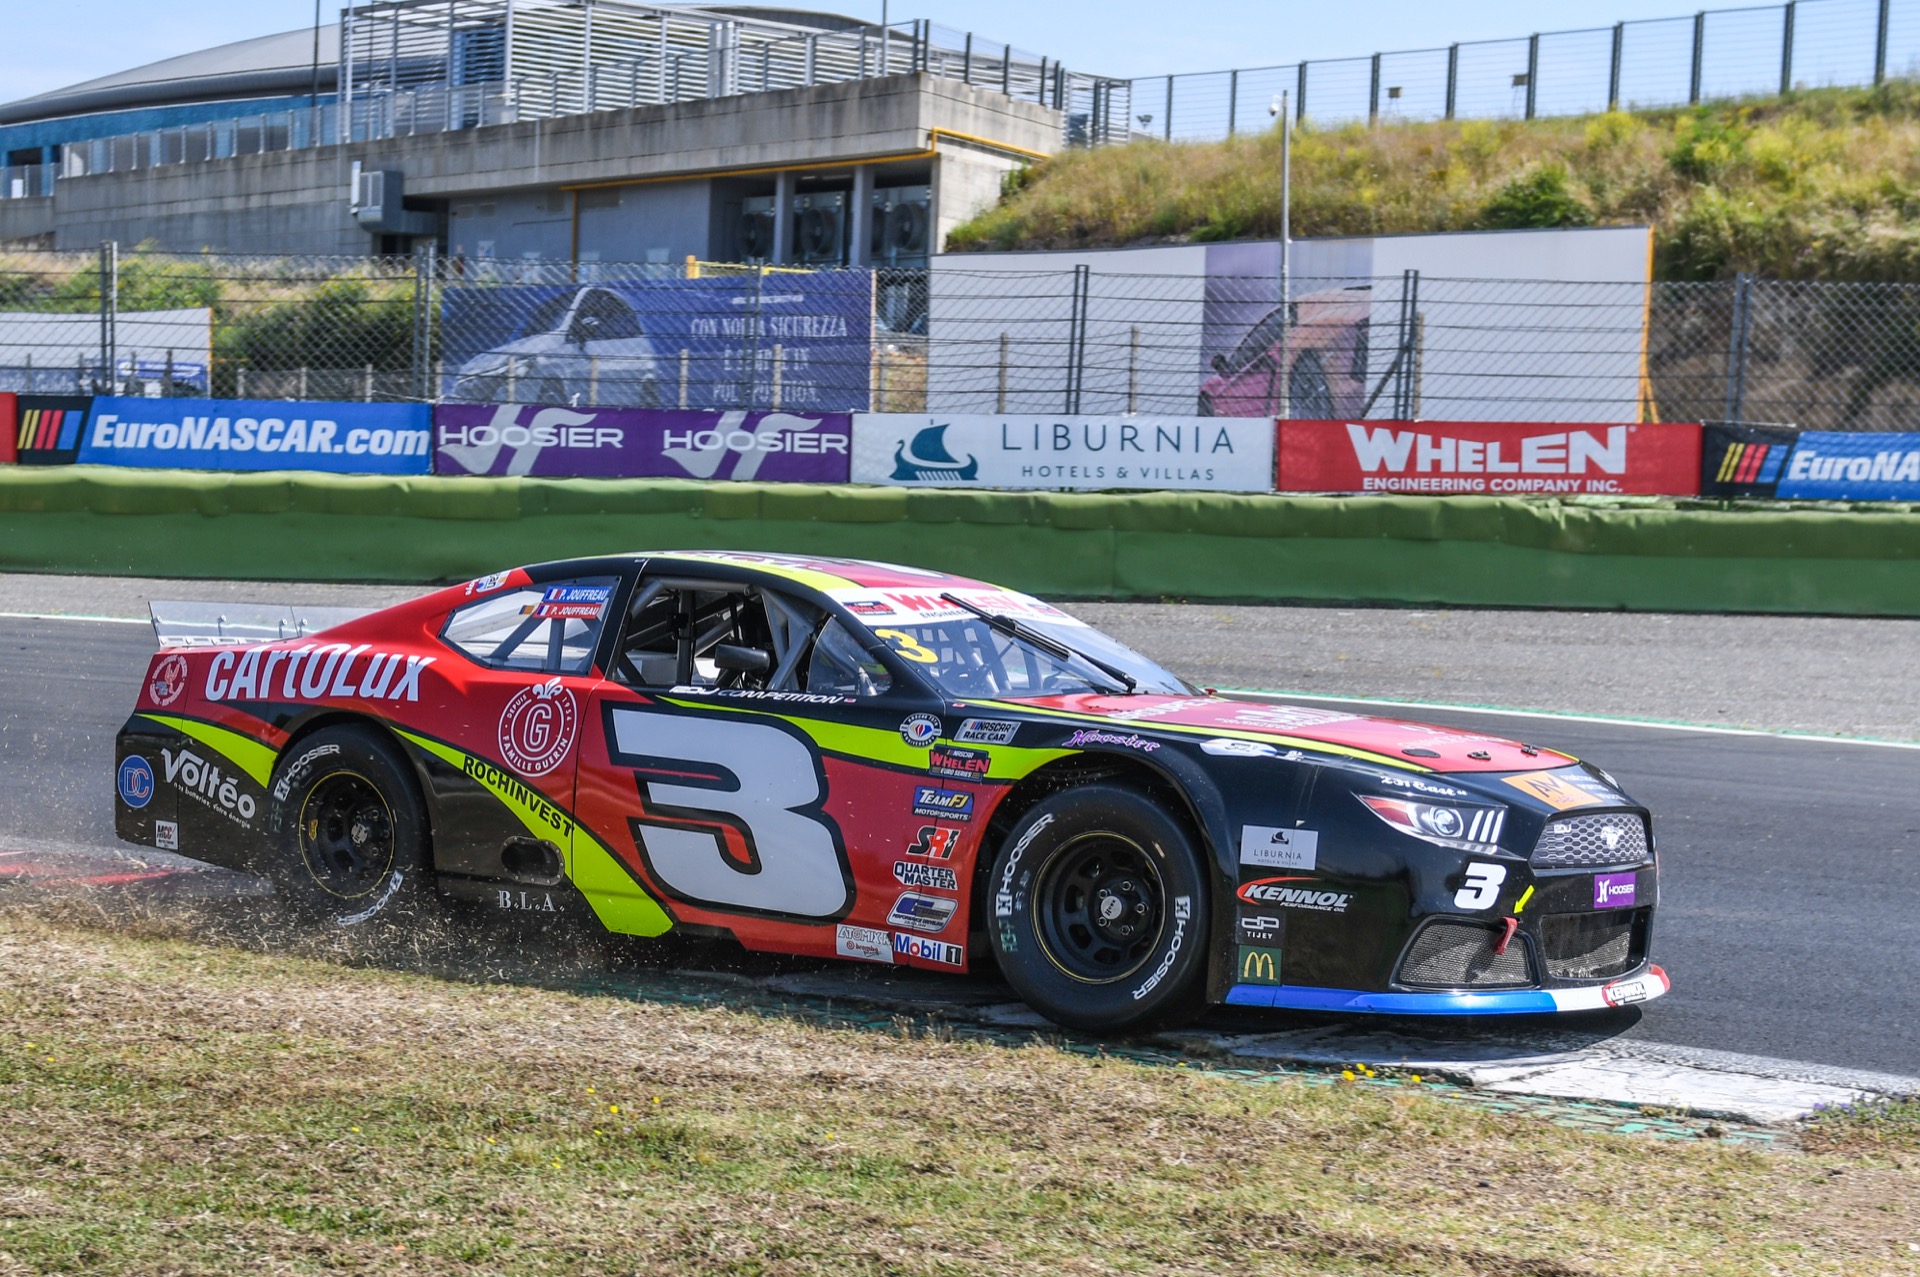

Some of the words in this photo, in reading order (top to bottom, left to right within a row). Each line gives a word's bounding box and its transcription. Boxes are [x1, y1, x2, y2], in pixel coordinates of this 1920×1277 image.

[771, 315, 848, 338] SICUREZZA
[736, 348, 789, 370] SEMPE
[91, 414, 430, 456] EuroNASCAR.com
[439, 425, 624, 449] HOOSIER
[663, 429, 848, 454] HOOSIER
[1002, 423, 1234, 454] LIBURNIA
[1345, 423, 1627, 474] WHELEN
[1022, 465, 1105, 478] HOTELS
[1116, 466, 1128, 478] &
[1140, 467, 1214, 481] VILLAS
[1362, 477, 1485, 491] ENGINEERING
[1490, 478, 1581, 492] COMPANY
[1586, 479, 1623, 493] INC.
[567, 588, 611, 601] JOUFFREAU
[882, 592, 1027, 612] WHLEN
[559, 605, 599, 616] JOUFFREAU
[875, 628, 938, 663] 3
[507, 694, 527, 719] DEPUIS
[562, 696, 572, 721] 1954
[718, 689, 844, 704] COMPETITION
[523, 703, 552, 752] G
[963, 731, 986, 740] RACE
[987, 732, 1006, 741] CAR
[978, 721, 1012, 732] NASCAR
[1062, 729, 1161, 752] Hoosier
[285, 744, 341, 783] HOOSIER
[502, 735, 532, 771] FAMILLE
[535, 738, 568, 771] GUERIN
[930, 751, 990, 773] WHELEN
[123, 766, 149, 798] DC
[463, 756, 575, 837] ROCHINVEST
[612, 708, 847, 917] 3
[914, 807, 969, 820] MOTORSPORTS
[907, 825, 960, 859] SRI
[1000, 813, 1055, 894] HOOSIER
[1253, 849, 1302, 860] LIBURNIA
[894, 861, 953, 879] QUARTER
[904, 873, 956, 890] MASTER
[1244, 884, 1350, 908] KENNOL
[1454, 862, 1507, 910] 3
[1608, 883, 1634, 895] HOOSIER
[1280, 901, 1333, 912] PERFORMANCE
[1246, 930, 1273, 940] TIJEY
[895, 933, 942, 961] Mobil
[949, 948, 957, 963] 1
[1132, 919, 1187, 1000] HOOSIER
